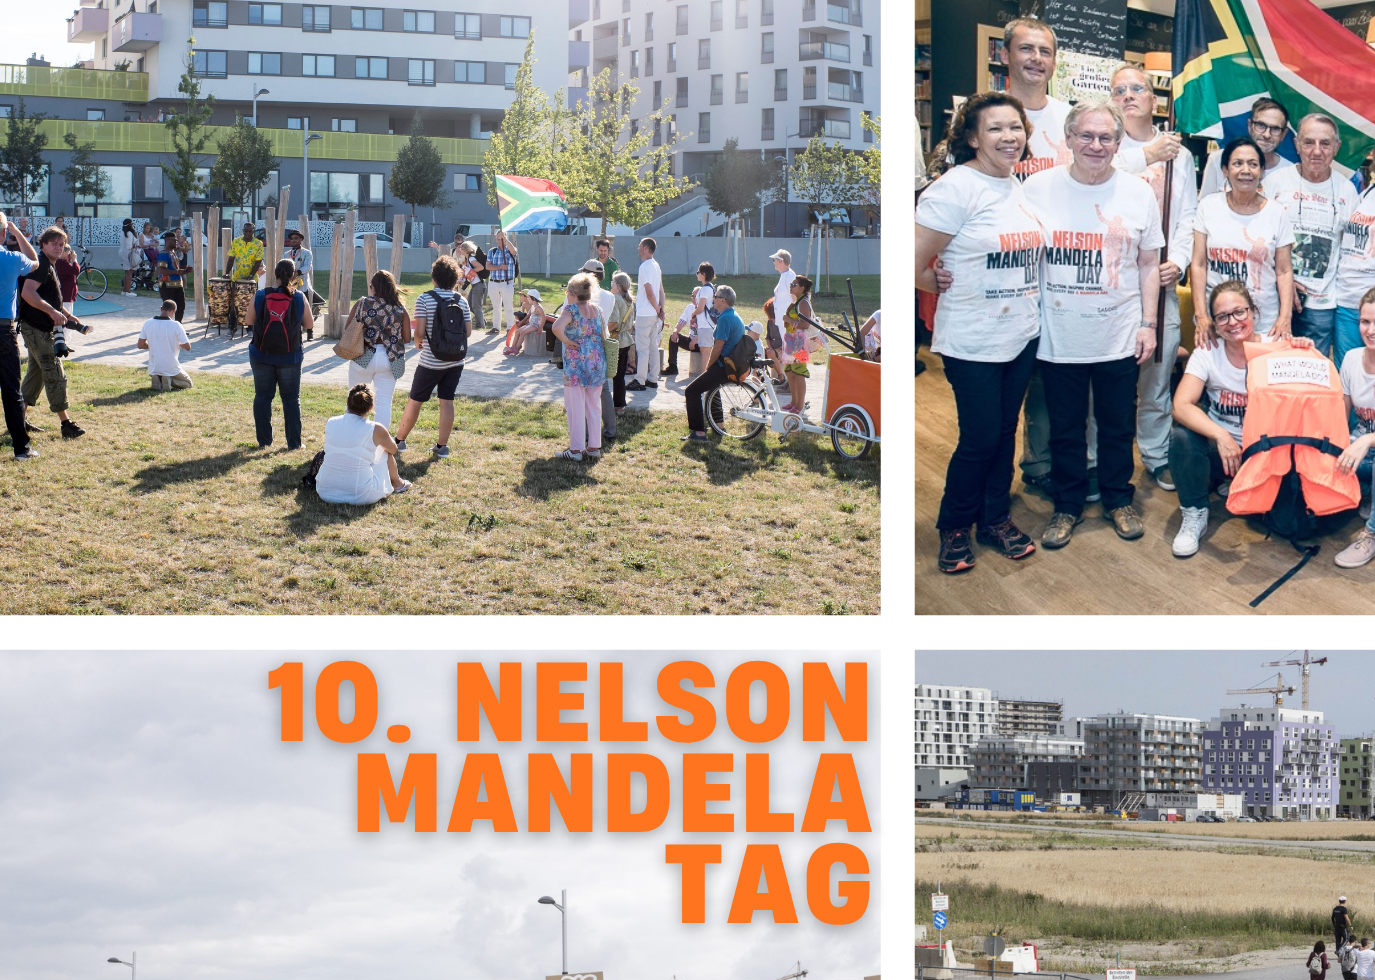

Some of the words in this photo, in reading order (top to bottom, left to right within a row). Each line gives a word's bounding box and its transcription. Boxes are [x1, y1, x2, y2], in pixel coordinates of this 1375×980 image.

[999, 231, 1041, 252] NELSON
[1053, 230, 1103, 250] NELSON
[1209, 247, 1247, 263] NELSON
[1273, 359, 1297, 369] WHAT
[1299, 360, 1327, 372] WOULD
[1219, 390, 1248, 404] NELSO
